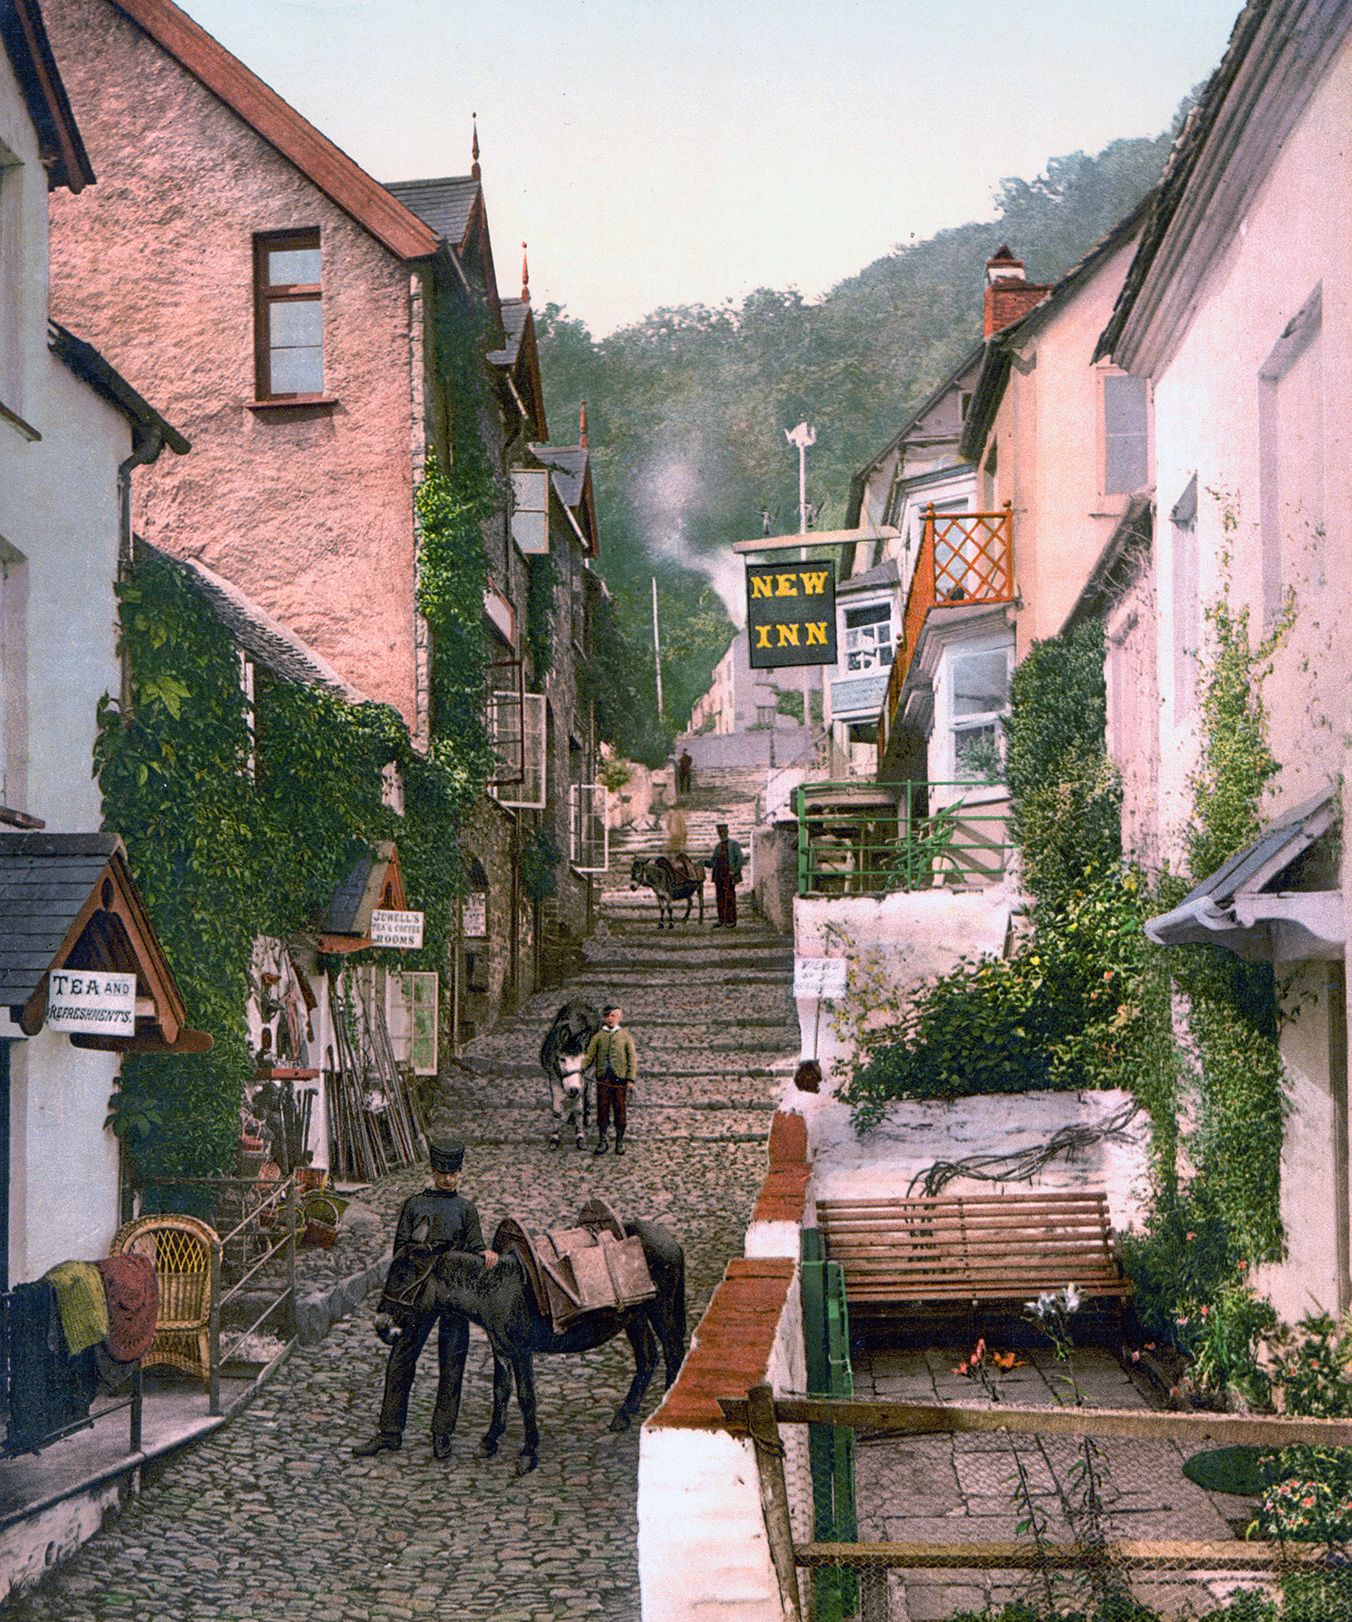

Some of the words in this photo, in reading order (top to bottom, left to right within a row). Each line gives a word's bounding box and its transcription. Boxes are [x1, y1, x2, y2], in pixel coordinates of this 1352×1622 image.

[750, 571, 829, 599] NEW
[755, 622, 829, 649] INN
[373, 911, 420, 923] JEWELL'S
[376, 934, 415, 945] ROOMS
[53, 975, 99, 996] TEA
[104, 982, 130, 995] AND
